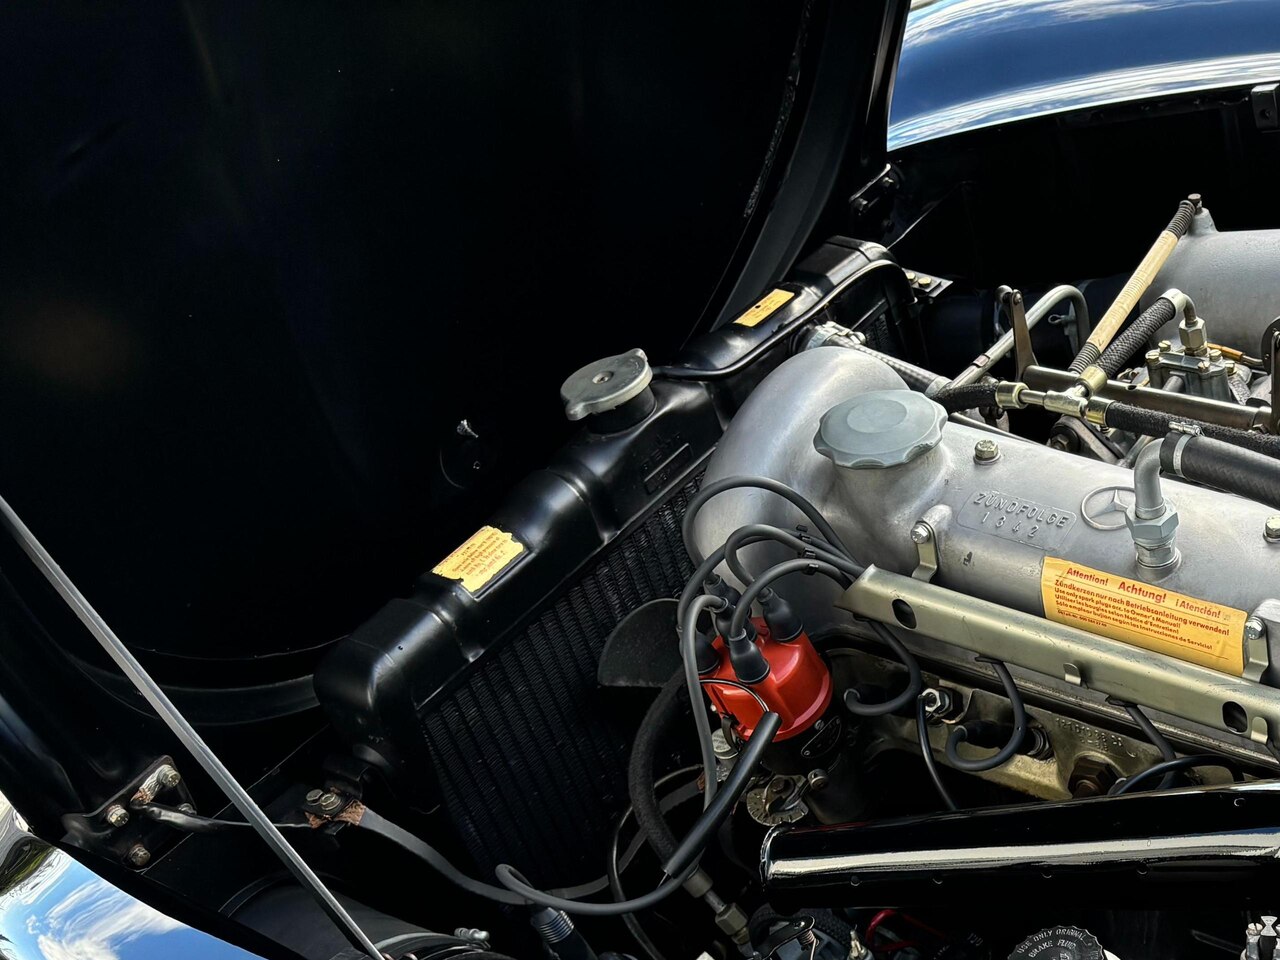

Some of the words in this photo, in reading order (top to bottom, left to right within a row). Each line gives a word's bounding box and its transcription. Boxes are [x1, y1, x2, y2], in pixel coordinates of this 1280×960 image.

[973, 492, 1070, 528] ZÜNDFOLGE
[981, 511, 990, 524] 1
[996, 515, 1007, 529] 3
[1011, 520, 1022, 533] 4
[1027, 525, 1040, 538] 2
[1054, 586, 1065, 595] Use
[1078, 593, 1094, 604] spark
[1066, 566, 1108, 586] Attention!
[1117, 579, 1166, 605] Achtung!
[1054, 578, 1094, 596] Zündkerzen
[1095, 591, 1108, 600] nur
[1108, 594, 1124, 605] nach
[1125, 599, 1187, 625] Betriebsanleitung
[1188, 617, 1229, 636] verwenden!
[1017, 939, 1033, 954] USE
[1033, 929, 1053, 942] ONLY
[1055, 928, 1085, 941] ORIGINAL
[1028, 939, 1054, 958] BRAKE
[1056, 938, 1077, 950] FLUID
